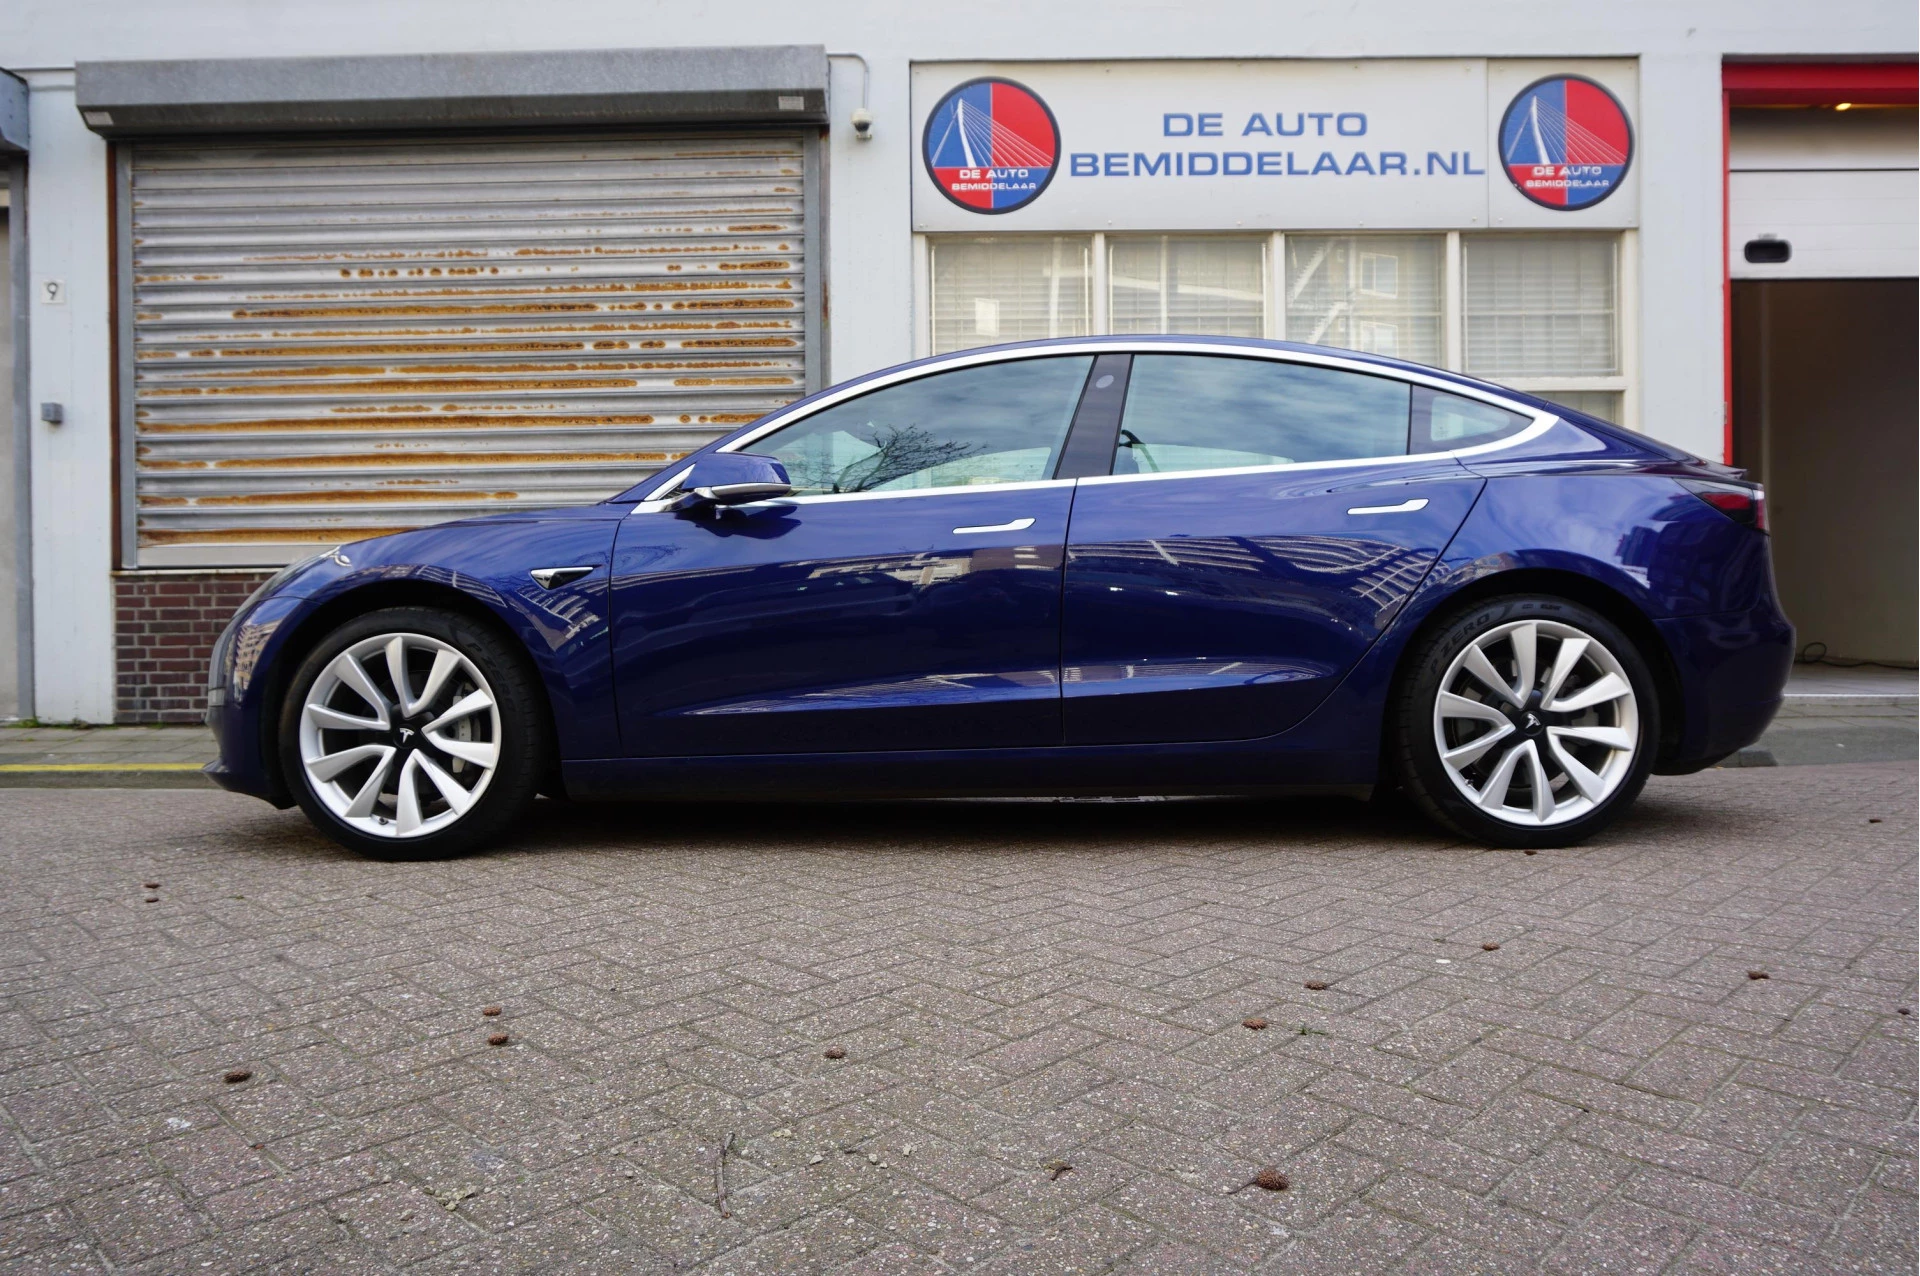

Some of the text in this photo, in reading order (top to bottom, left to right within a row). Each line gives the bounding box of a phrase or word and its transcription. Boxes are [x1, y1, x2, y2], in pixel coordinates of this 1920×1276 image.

[1163, 112, 1367, 136] DE AUTO
[1070, 151, 1485, 176] BEMIDDELAAR.NL
[960, 169, 1028, 179] DE AUTO
[1533, 166, 1602, 176] DE AUTO
[951, 182, 1037, 190] BEMIDDELAAR
[1525, 180, 1610, 188] BEMIDDELAAR
[47, 282, 58, 300] 9
[1440, 613, 1490, 657] ZERO
